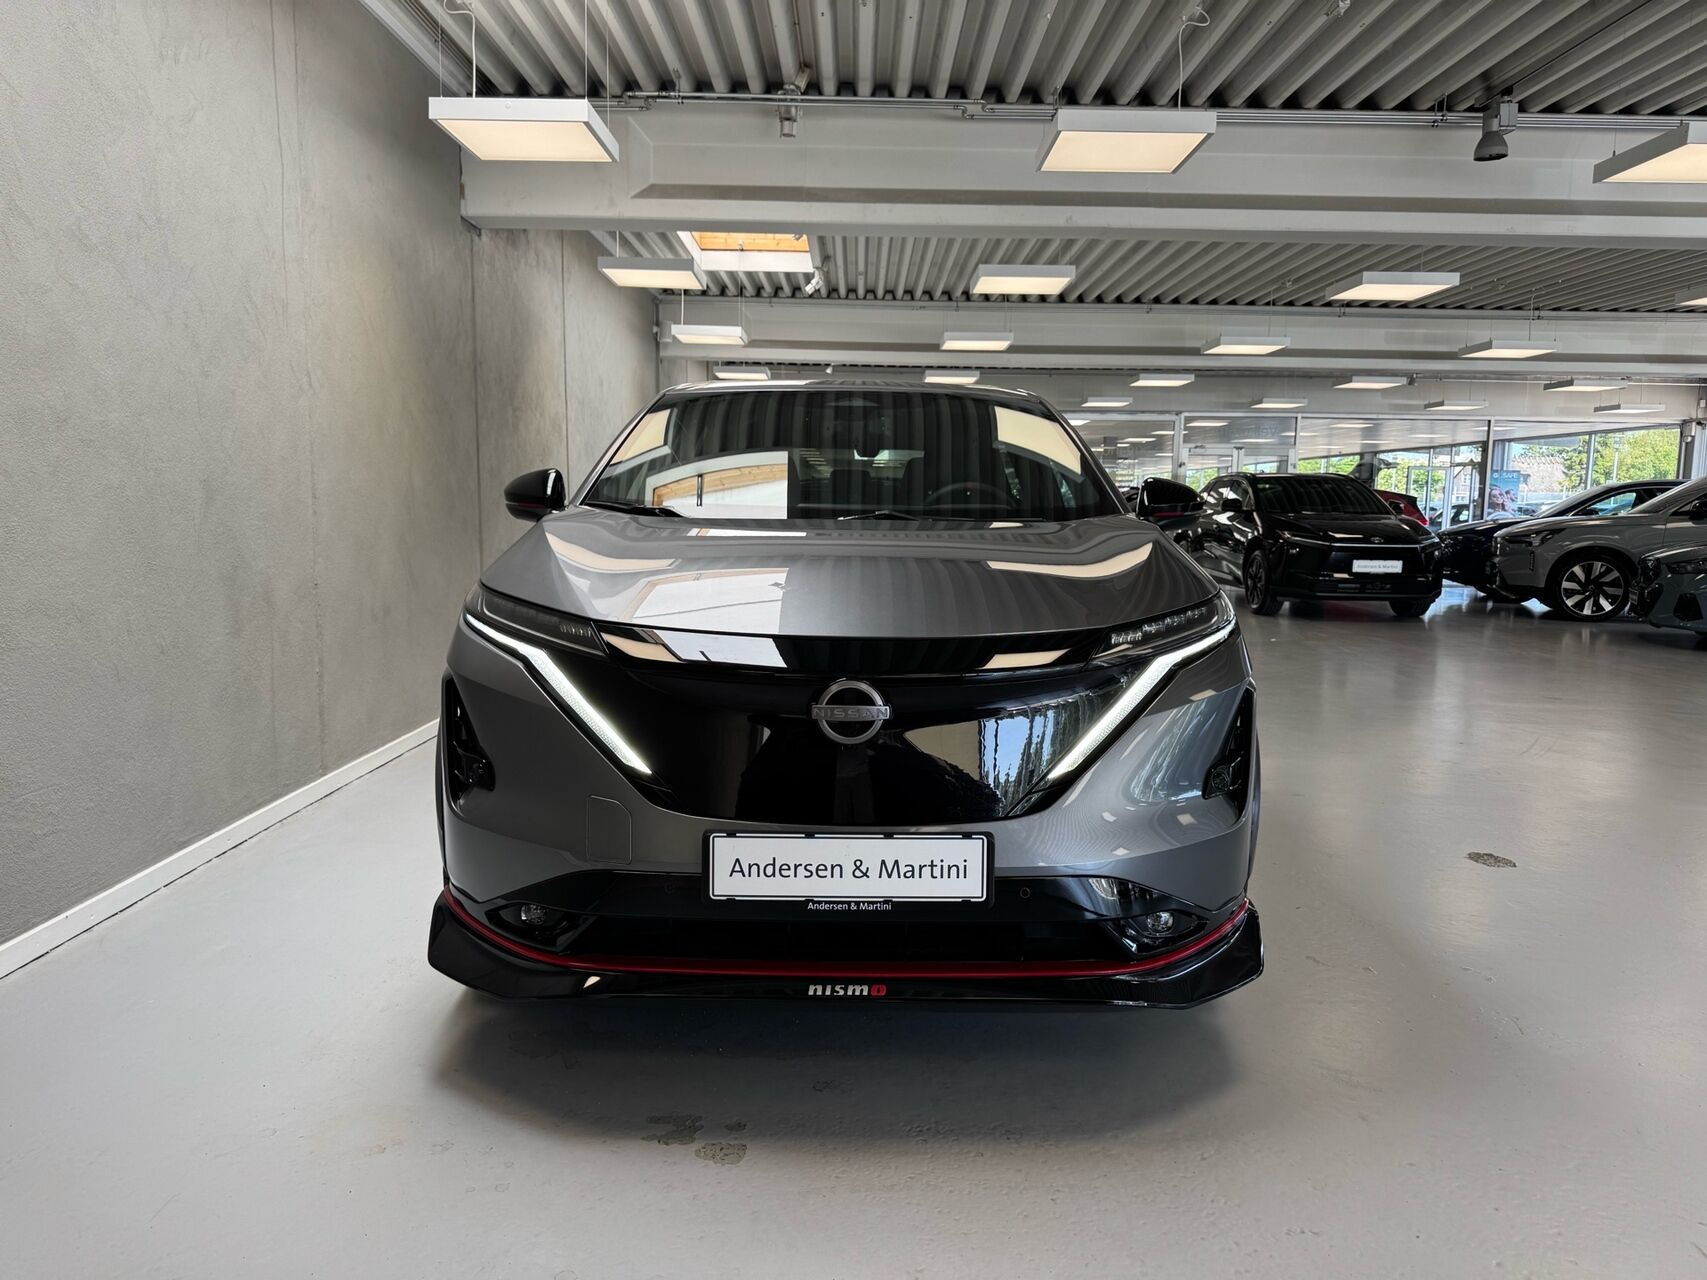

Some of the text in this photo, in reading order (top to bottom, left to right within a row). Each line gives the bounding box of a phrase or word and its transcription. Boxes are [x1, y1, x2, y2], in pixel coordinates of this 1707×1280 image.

[814, 707, 888, 719] NISSAN
[729, 857, 969, 880] Andersen & Martini
[807, 902, 892, 911] Andersen & Martini
[808, 983, 887, 997] nismo
